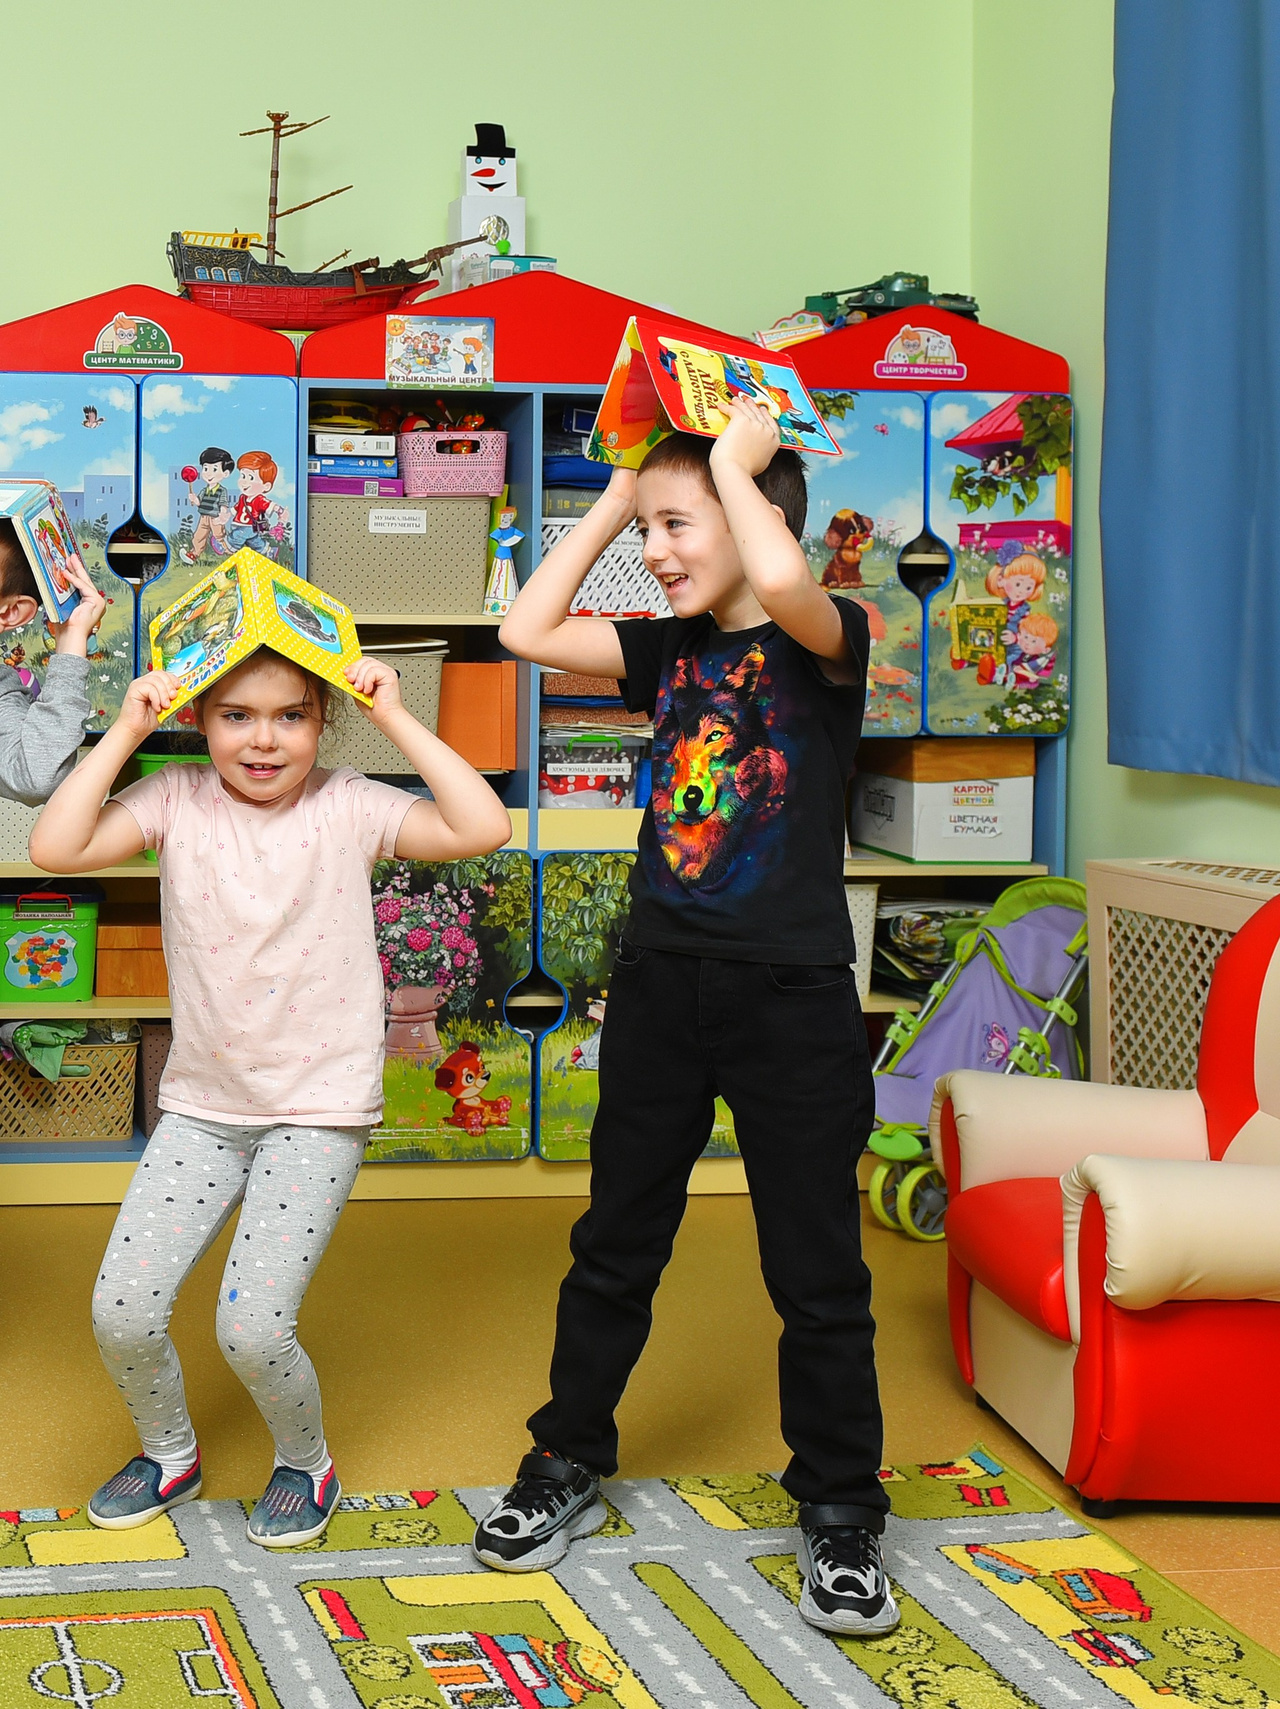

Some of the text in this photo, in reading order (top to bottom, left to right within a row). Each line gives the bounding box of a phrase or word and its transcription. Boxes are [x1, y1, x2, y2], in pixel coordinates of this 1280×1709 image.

[91, 356, 175, 365] ЦЕНТР МАТЕМАТИКИ
[882, 366, 958, 375] ЦЕНТР ТВОРЧЕСТВА
[389, 375, 457, 383] МУЗЫКАЛЬНЫЙ
[697, 368, 719, 410] ЛИСА
[954, 785, 994, 794] КАРТОН
[953, 797, 994, 805] ЦВЕТНОЙ
[949, 815, 998, 824] ЦВЕТНАЯ
[954, 825, 997, 834] БУМАГА
